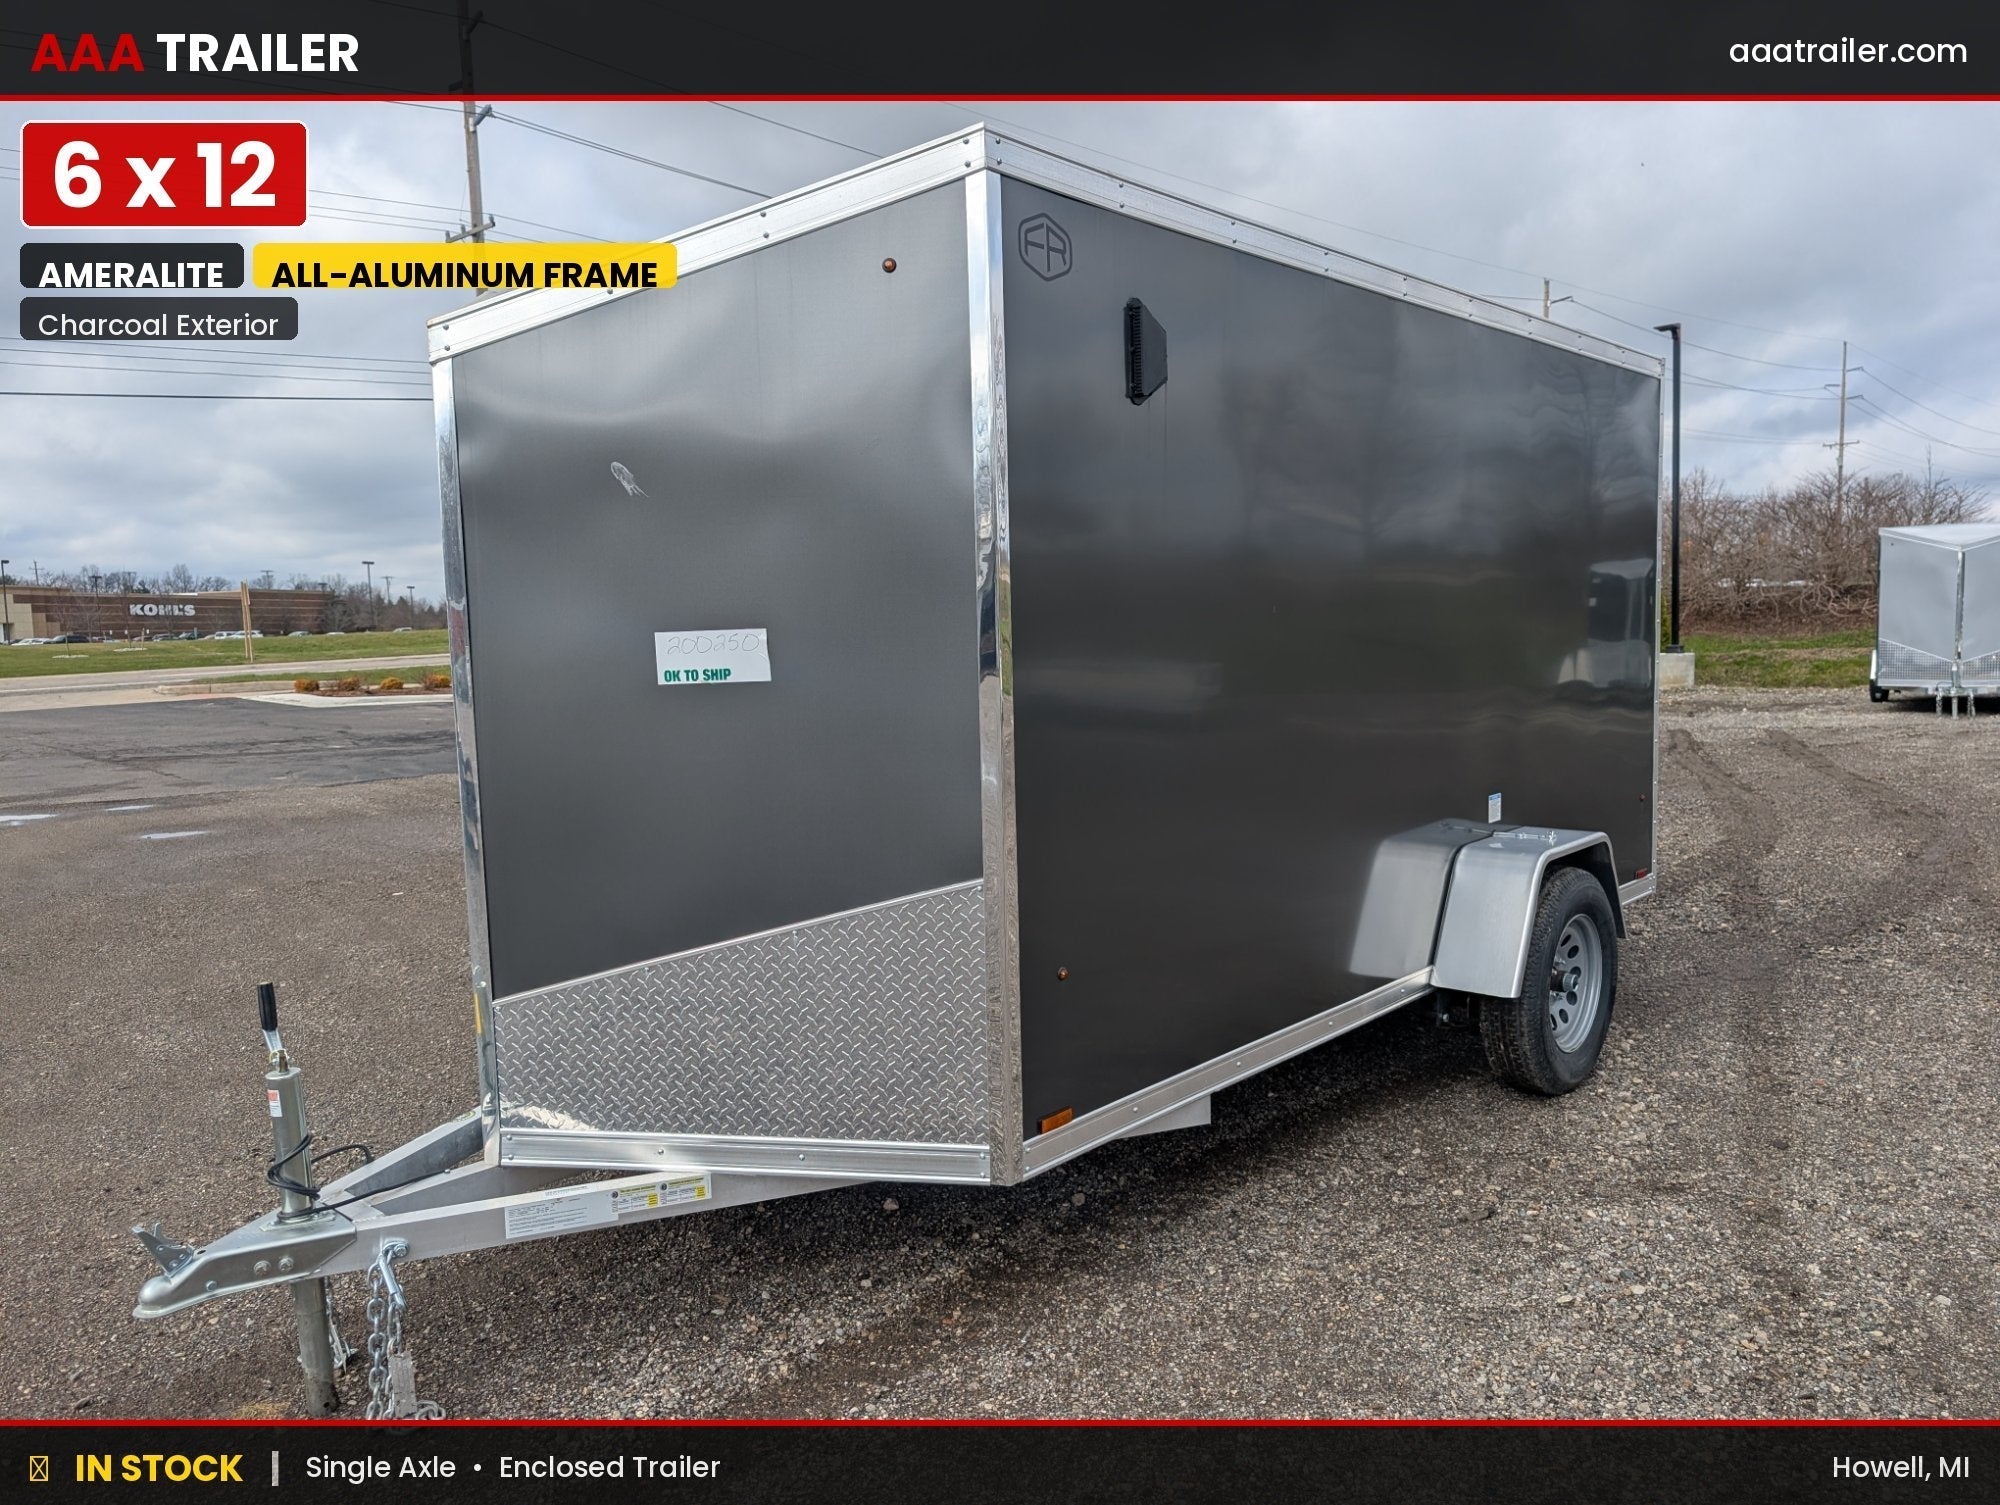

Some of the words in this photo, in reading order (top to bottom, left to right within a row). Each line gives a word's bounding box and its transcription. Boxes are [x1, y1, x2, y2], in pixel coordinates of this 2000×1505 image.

[129, 603, 196, 617] KOHL'S
[663, 669, 682, 683] OK
[684, 669, 700, 682] TO
[702, 667, 732, 681] SHIP
